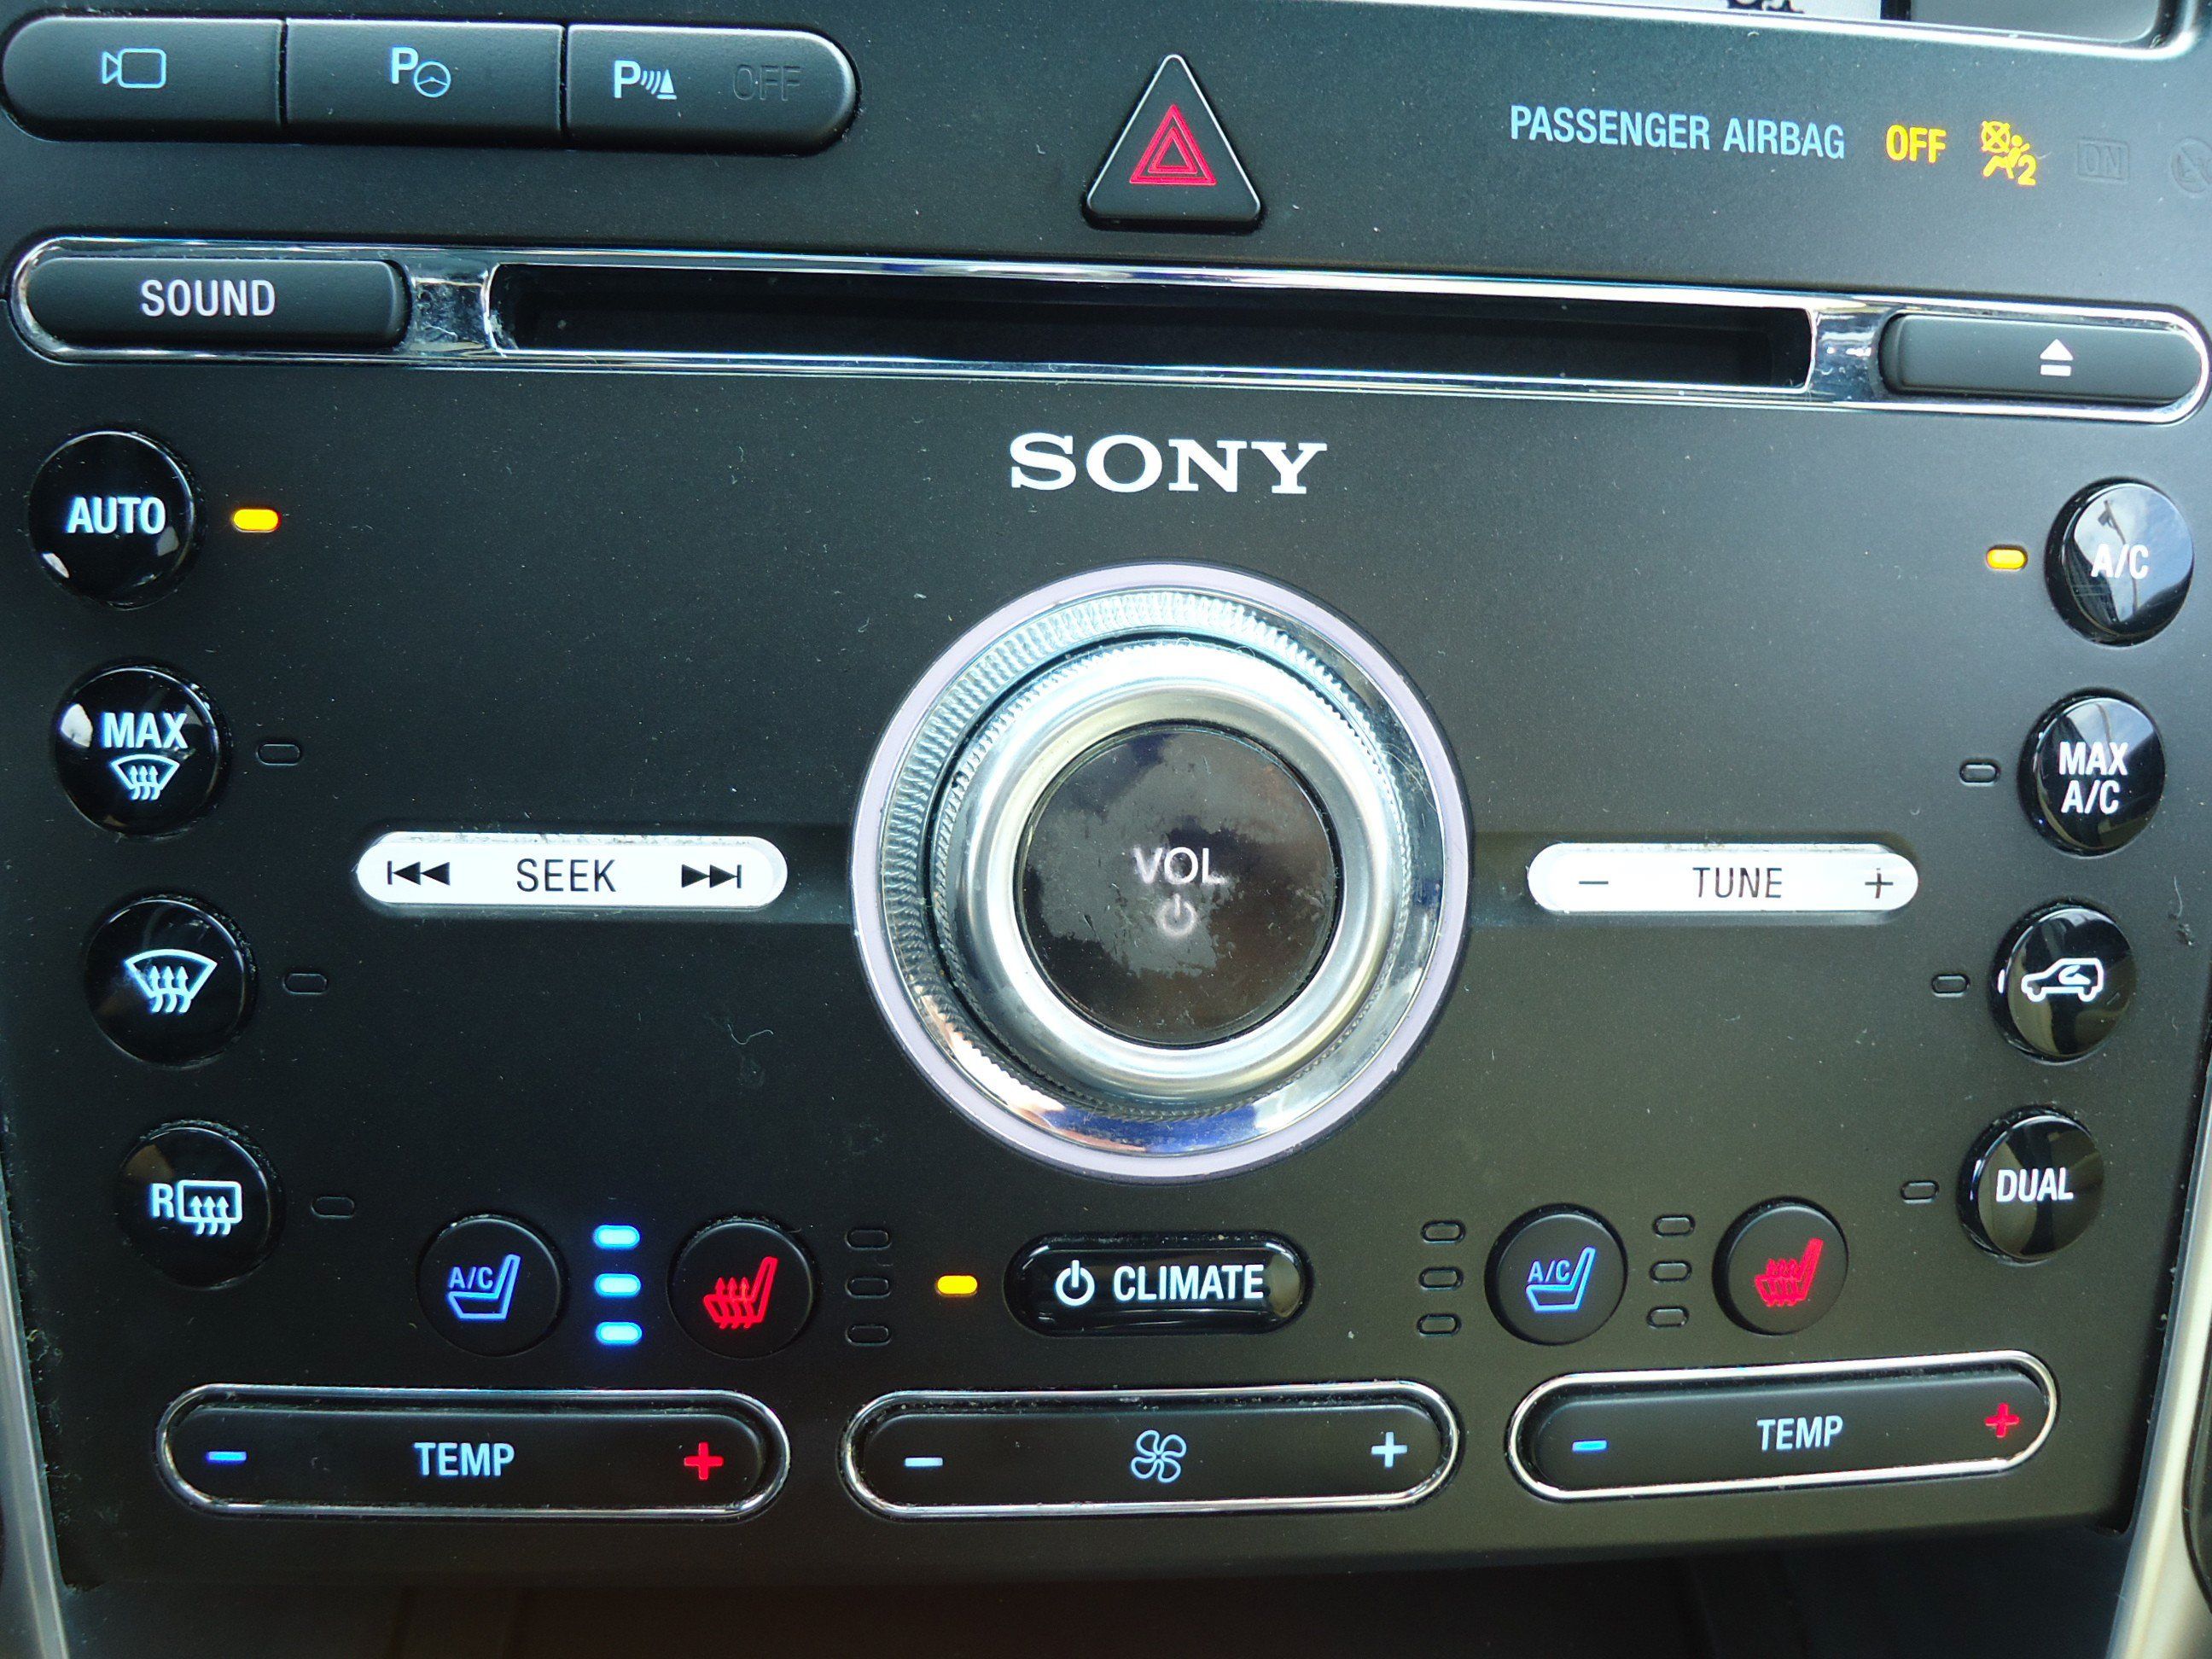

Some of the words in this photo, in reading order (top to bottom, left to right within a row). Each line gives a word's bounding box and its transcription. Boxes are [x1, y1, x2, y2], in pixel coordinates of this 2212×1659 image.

[731, 64, 801, 102] OFF
[1510, 105, 1710, 150] PASSENGER
[1722, 115, 1846, 160] AIRBAG
[1885, 124, 1947, 163] OFF
[140, 279, 276, 318] SOUND
[1009, 431, 1328, 494] SONY
[66, 496, 166, 534] AUTO
[2090, 543, 2150, 579] A/C
[101, 712, 189, 748] MAX
[2058, 741, 2128, 776] MAX
[2060, 779, 2122, 815] A/C
[515, 858, 617, 893] SEEK
[1132, 846, 1230, 886] VOL
[1691, 866, 1784, 899] TUNE
[1995, 1167, 2074, 1202] DUAL
[448, 1266, 495, 1290] A/C
[1112, 1263, 1266, 1301] CLIMATE
[1528, 1259, 1571, 1284] A/C
[1755, 1415, 1844, 1452] TEMP
[414, 1441, 515, 1477] TEMP
